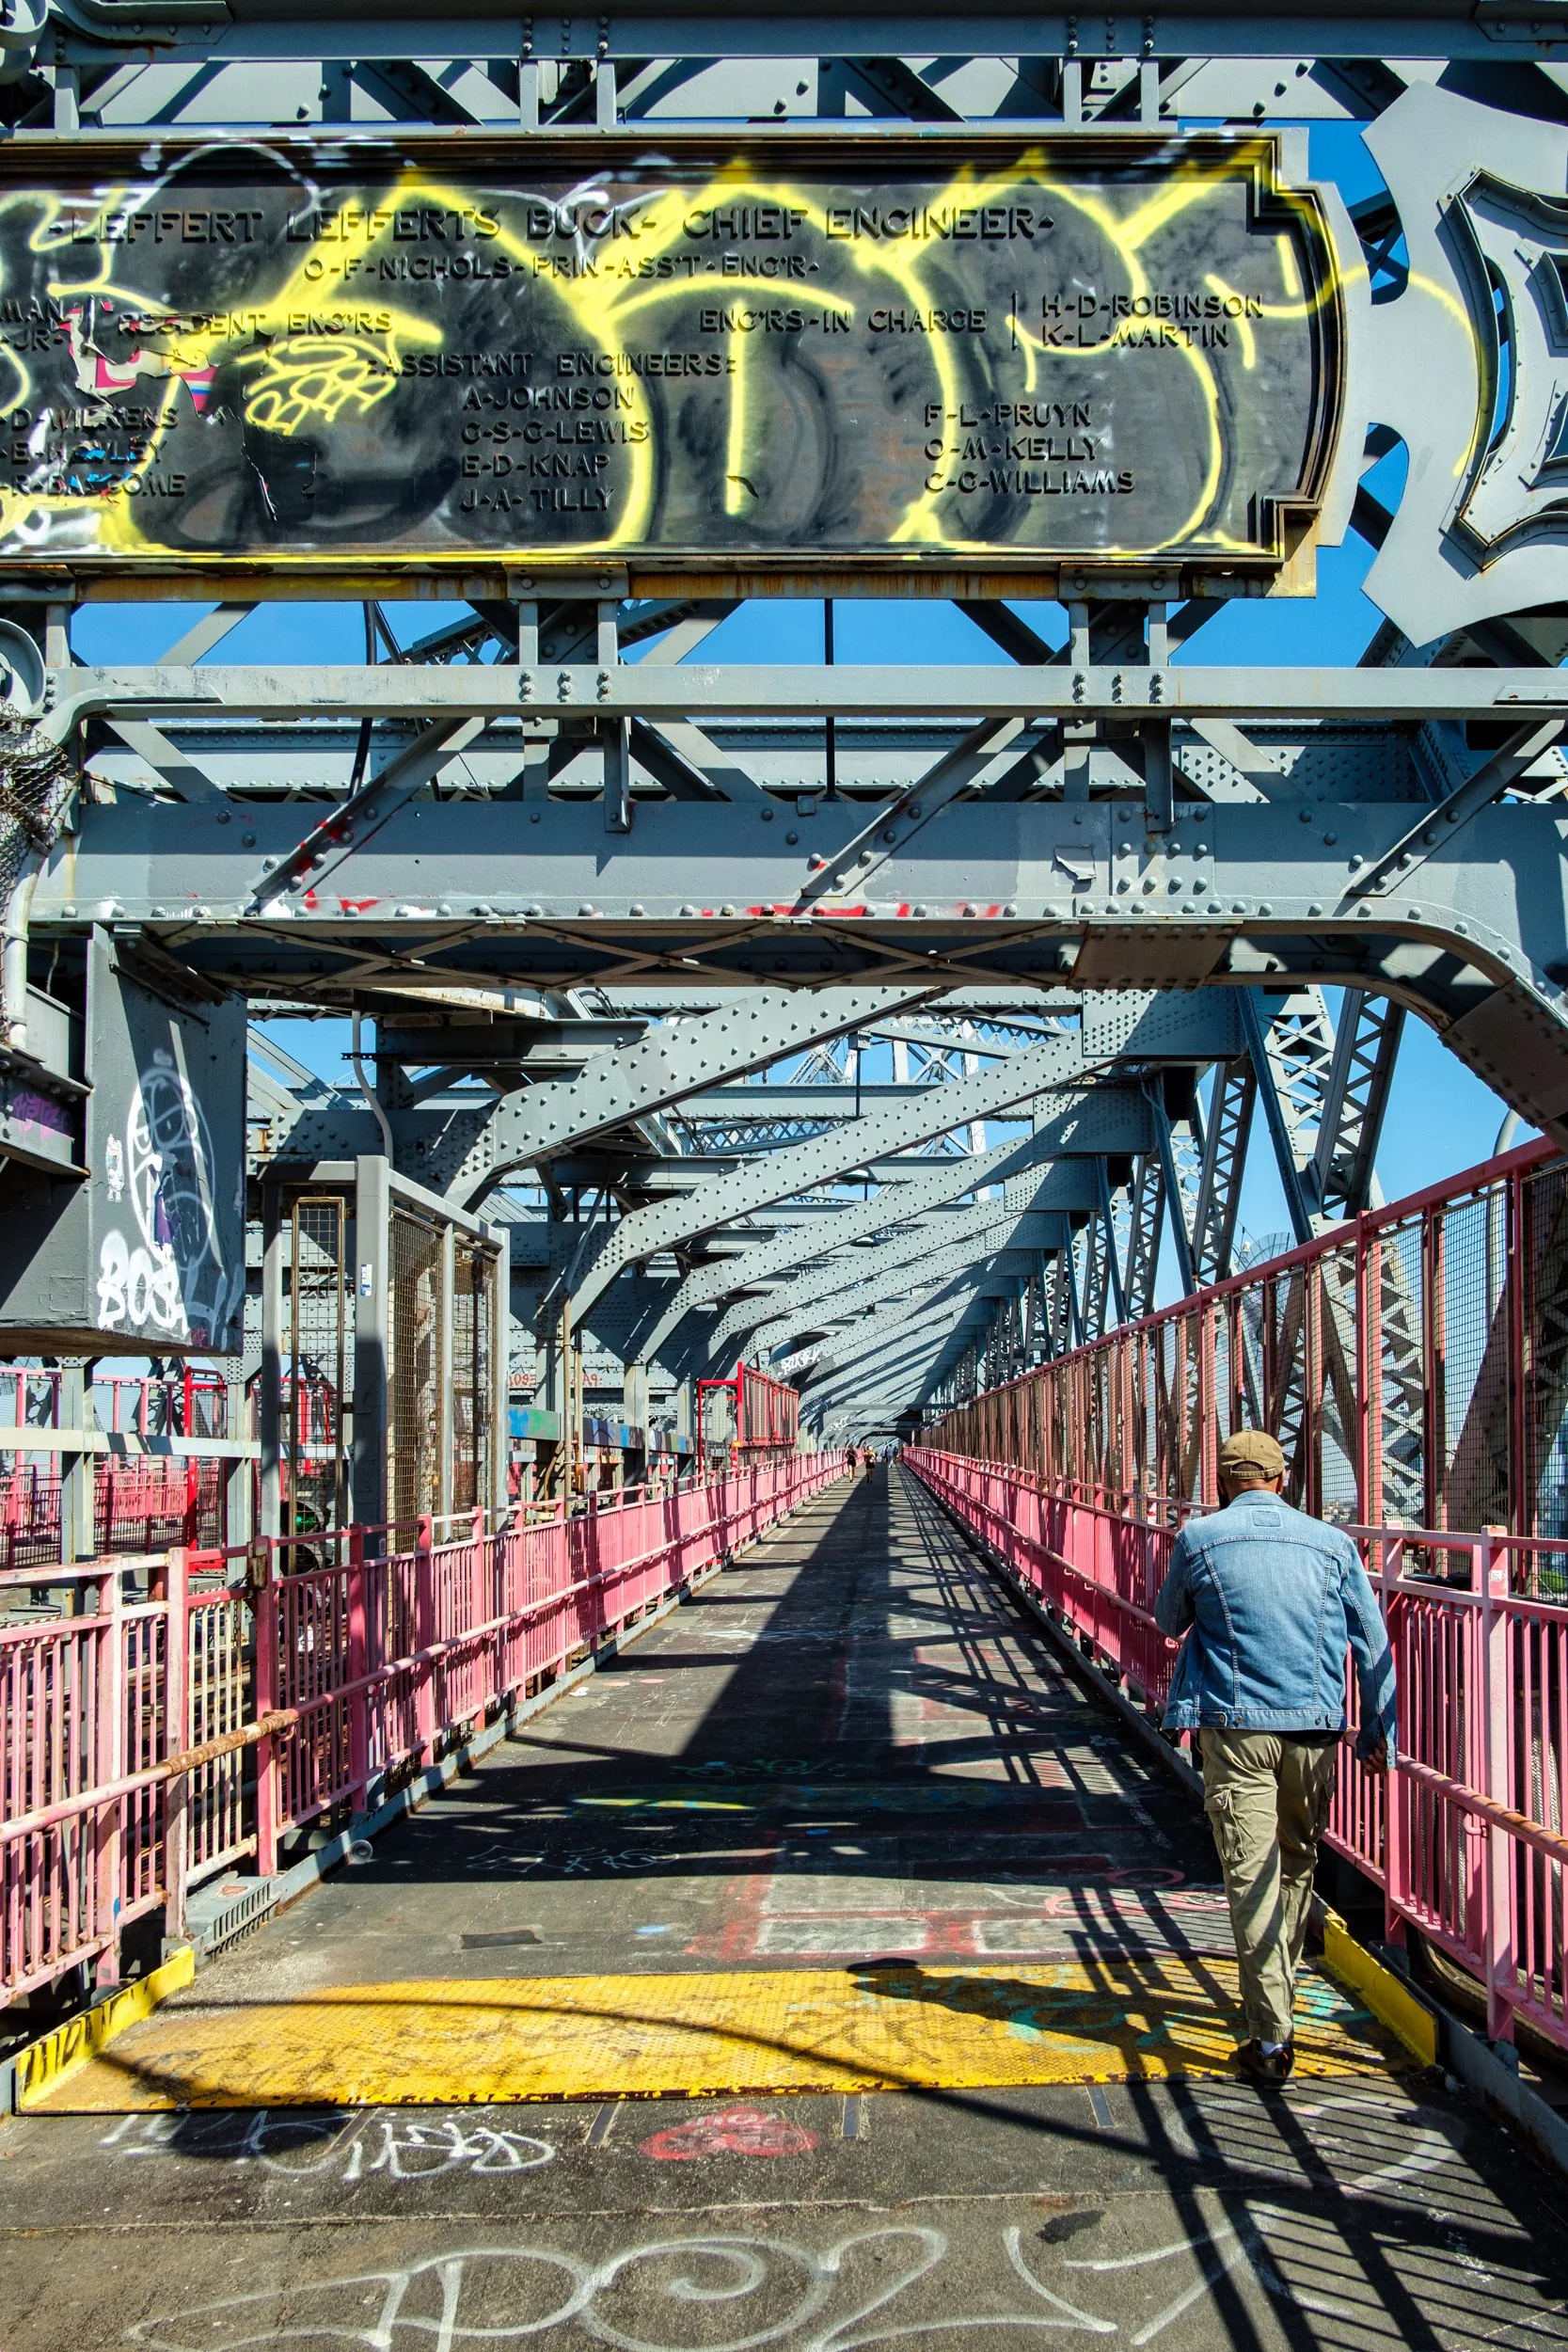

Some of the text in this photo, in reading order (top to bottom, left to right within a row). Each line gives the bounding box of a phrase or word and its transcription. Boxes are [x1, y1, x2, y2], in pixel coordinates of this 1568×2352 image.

[70, 209, 264, 245] LEFFERT
[285, 206, 500, 243] LEFFERTS
[682, 206, 809, 241] CHIEF
[867, 308, 988, 334] CHARGE
